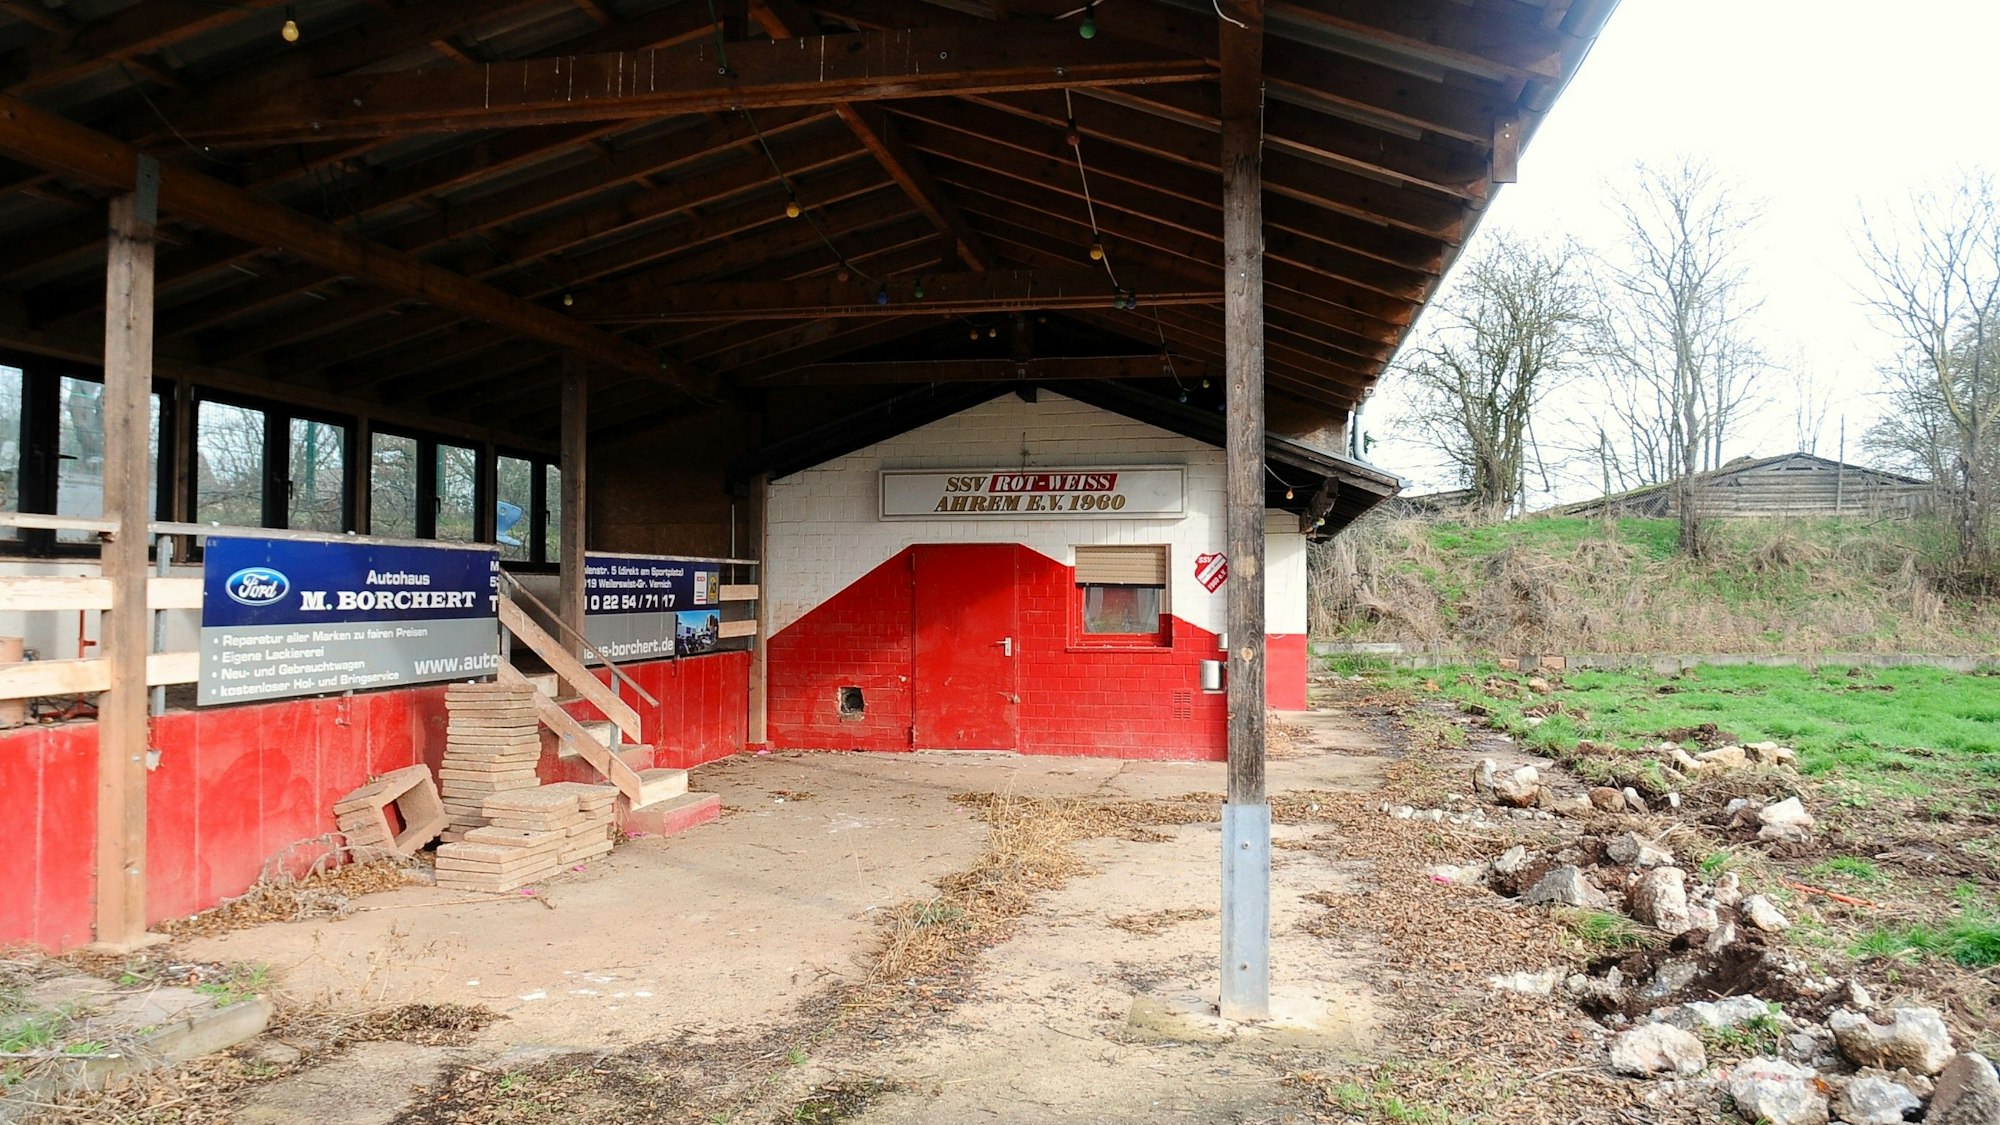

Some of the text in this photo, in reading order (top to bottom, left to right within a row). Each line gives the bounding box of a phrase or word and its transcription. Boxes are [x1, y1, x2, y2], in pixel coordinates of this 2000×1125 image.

[945, 474, 1111, 492] SSV ROT-WEISS
[934, 494, 1126, 512] AHREM E.V. 1960
[366, 570, 430, 585] Autohaus
[611, 566, 617, 575] 5
[640, 568, 650, 576] am
[238, 573, 279, 598] Ford
[649, 579, 671, 589] Vernich
[300, 591, 476, 611] M. BORCHERT
[590, 595, 600, 610] 0
[602, 595, 619, 610] 22
[662, 594, 675, 608] 17
[222, 627, 428, 648] Reparatur aller Marken zu fairen Preisen
[221, 646, 324, 664] Eigene Lackiererei
[221, 659, 365, 680] Neu- und Gebrauchtwagen
[220, 670, 399, 697] kostenloser Hol- und Bringservice
